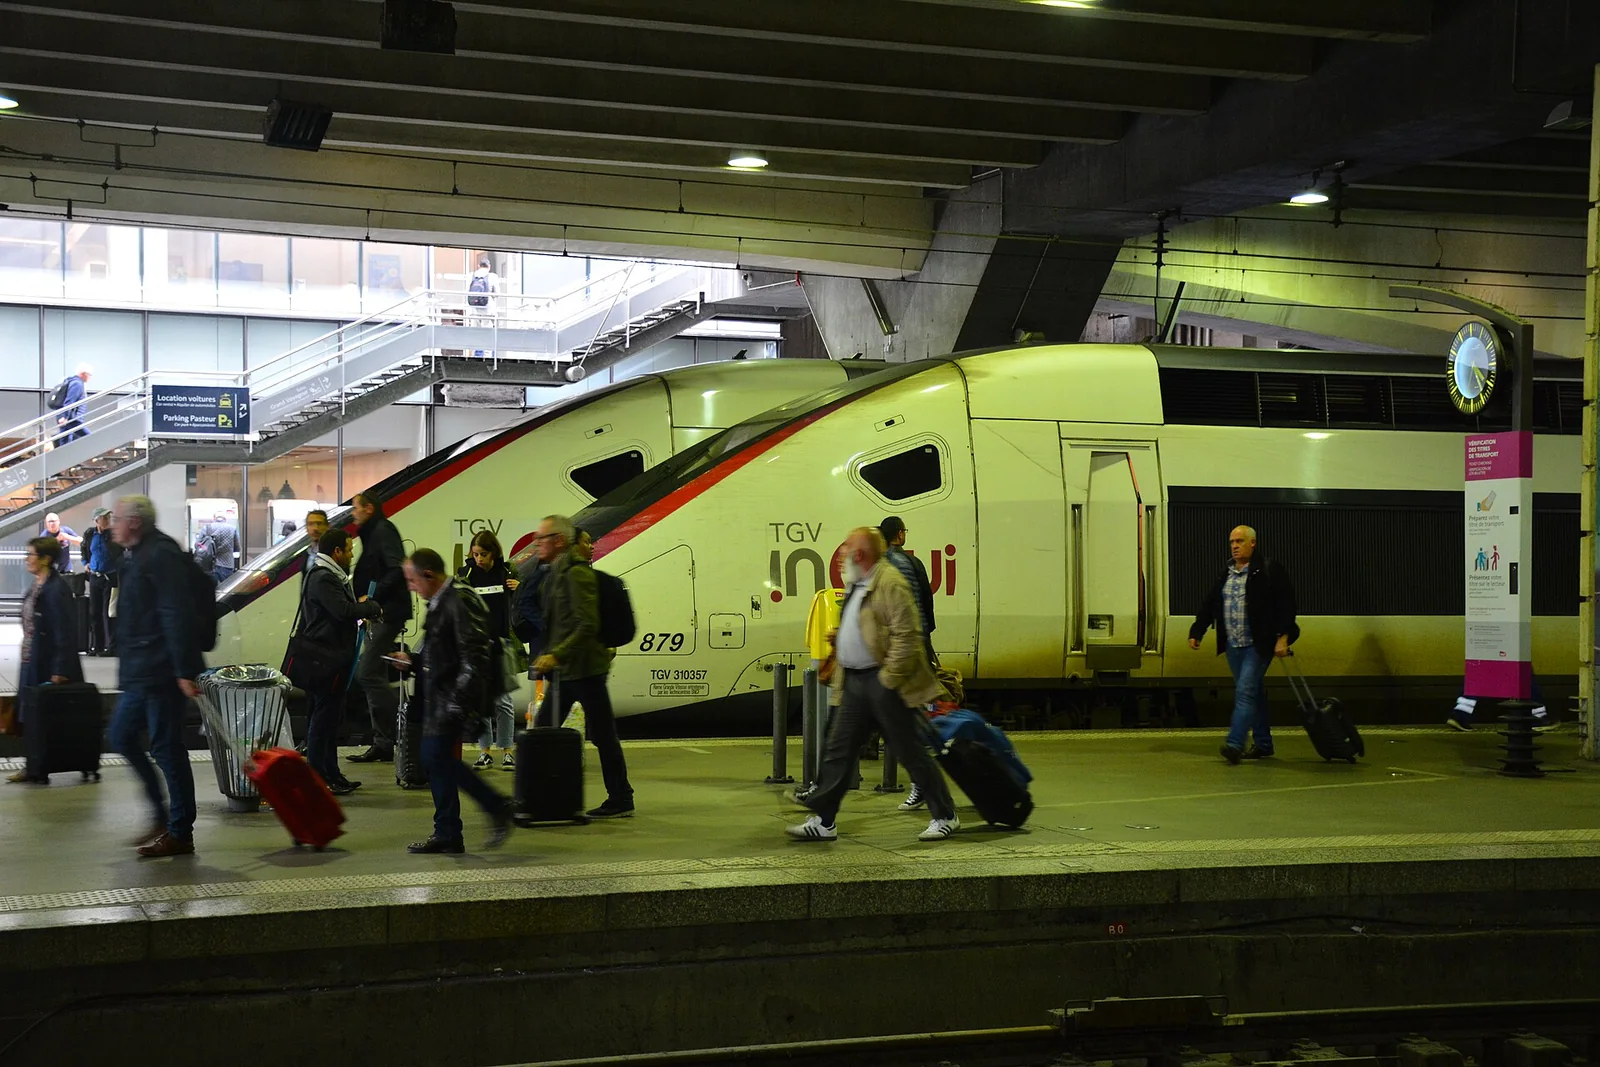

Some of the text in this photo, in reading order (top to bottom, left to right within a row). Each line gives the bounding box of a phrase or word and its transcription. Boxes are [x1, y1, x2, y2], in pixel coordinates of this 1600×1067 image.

[157, 394, 217, 403] Location voitures
[163, 414, 217, 424] Parking Pasteur
[1468, 438, 1496, 446] VÉRIFICATION
[454, 518, 503, 536] TGV
[769, 522, 822, 543] TGV
[640, 632, 684, 652] 879
[650, 670, 708, 680] TGV 310357
